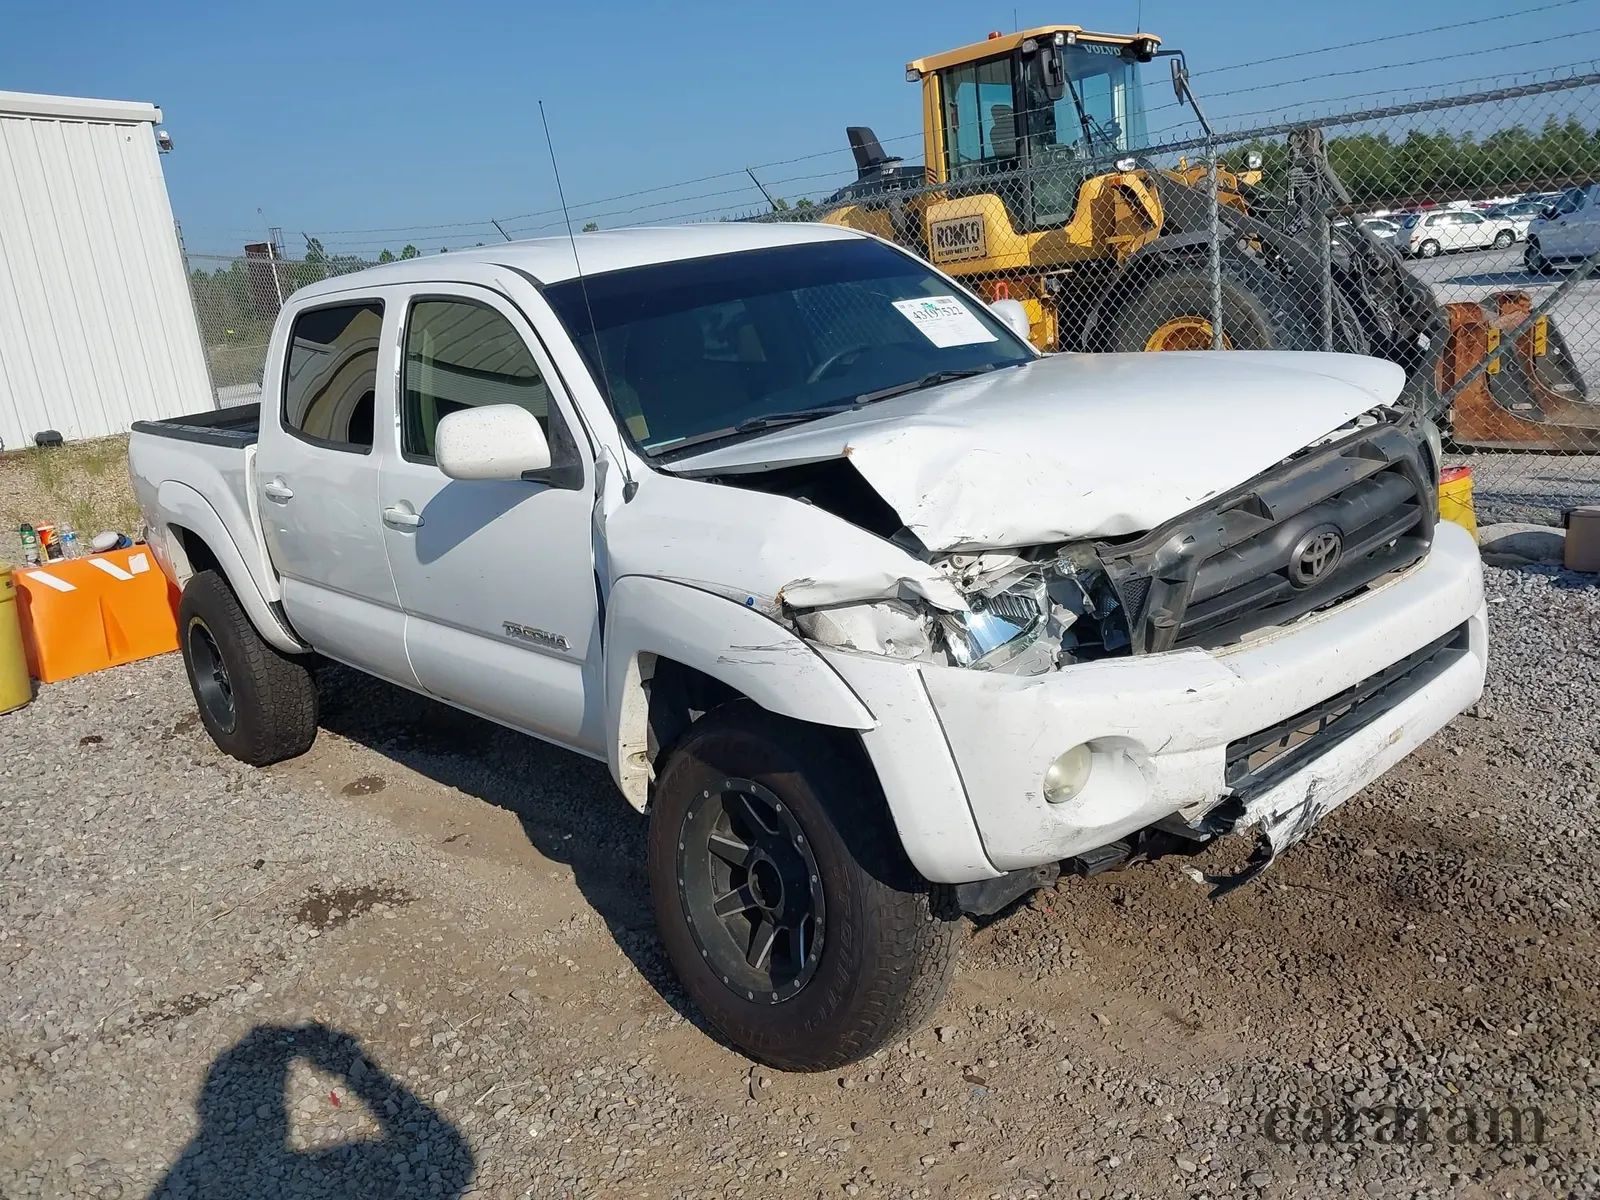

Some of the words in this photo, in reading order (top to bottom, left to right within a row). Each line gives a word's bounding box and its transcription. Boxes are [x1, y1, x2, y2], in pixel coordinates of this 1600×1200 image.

[1082, 44, 1121, 56] VOLVO
[936, 221, 980, 248] ROMCO
[502, 620, 571, 652] TACOMA
